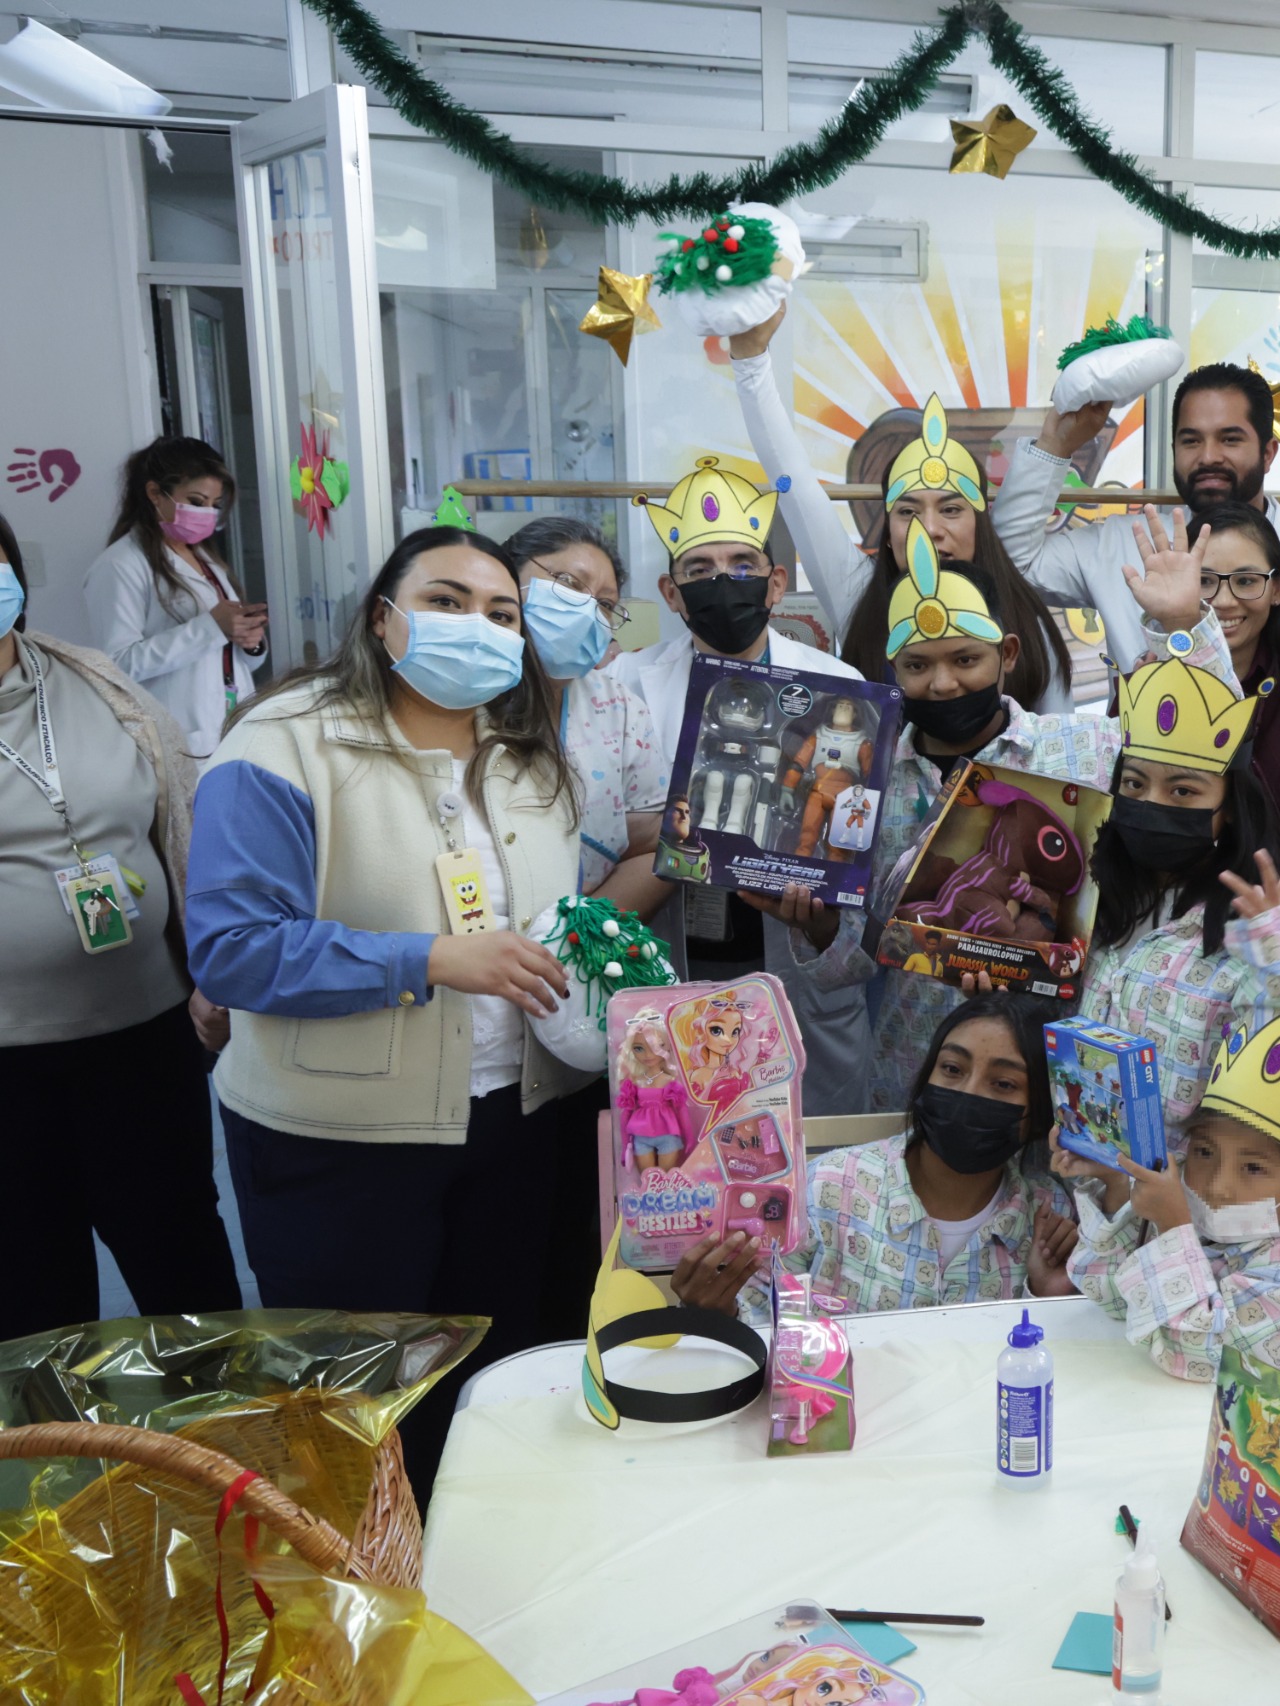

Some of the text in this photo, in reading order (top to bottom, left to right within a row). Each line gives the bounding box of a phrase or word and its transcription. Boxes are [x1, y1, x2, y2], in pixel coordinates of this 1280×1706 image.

[790, 686, 804, 697] 7
[42, 723, 53, 763] IZTACALCO
[16, 756, 50, 788] HOSPITAL
[731, 855, 826, 880] LIGHTYEAR
[781, 857, 799, 865] PIXAR
[738, 878, 762, 888] BUZZ
[957, 941, 1024, 963] PARASAUROLOPHUS
[945, 953, 989, 971] JURASSIC
[990, 961, 1030, 981] WORLD
[759, 1065, 786, 1081] Barbie
[1144, 1065, 1154, 1084] CITY
[728, 1159, 757, 1173] Barbie
[647, 1172, 690, 1195] Barbie
[623, 1187, 716, 1217] DREAM
[638, 1212, 698, 1232] BESTIES
